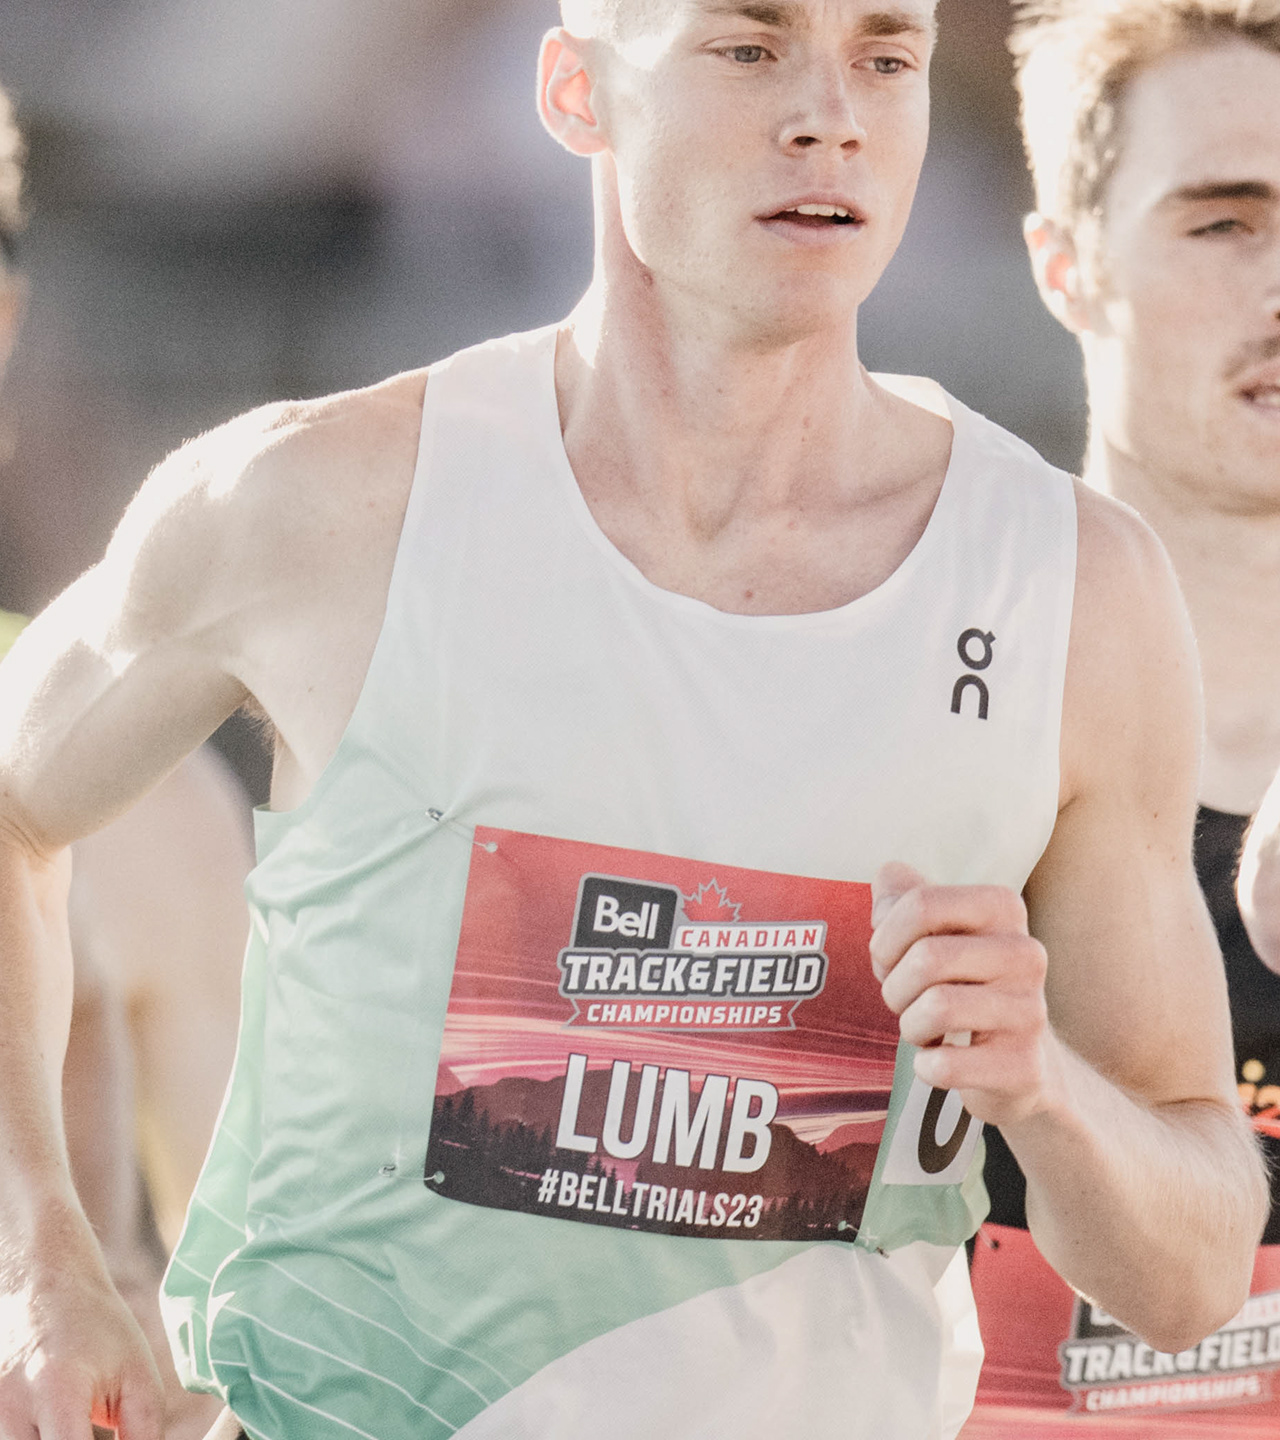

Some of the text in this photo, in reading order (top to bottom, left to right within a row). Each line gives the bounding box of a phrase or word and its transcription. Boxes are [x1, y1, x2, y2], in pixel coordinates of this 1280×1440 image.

[593, 894, 660, 941] Bell
[681, 927, 818, 949] CANADIAN
[565, 954, 821, 996] TRACK&FIELD
[586, 1002, 783, 1026] CHAMPIONSHIPS
[555, 1053, 779, 1174] LUMB
[537, 1167, 763, 1229] #BELLTRIALS23
[1086, 1375, 1261, 1412] CHAMPIONSHIPS
